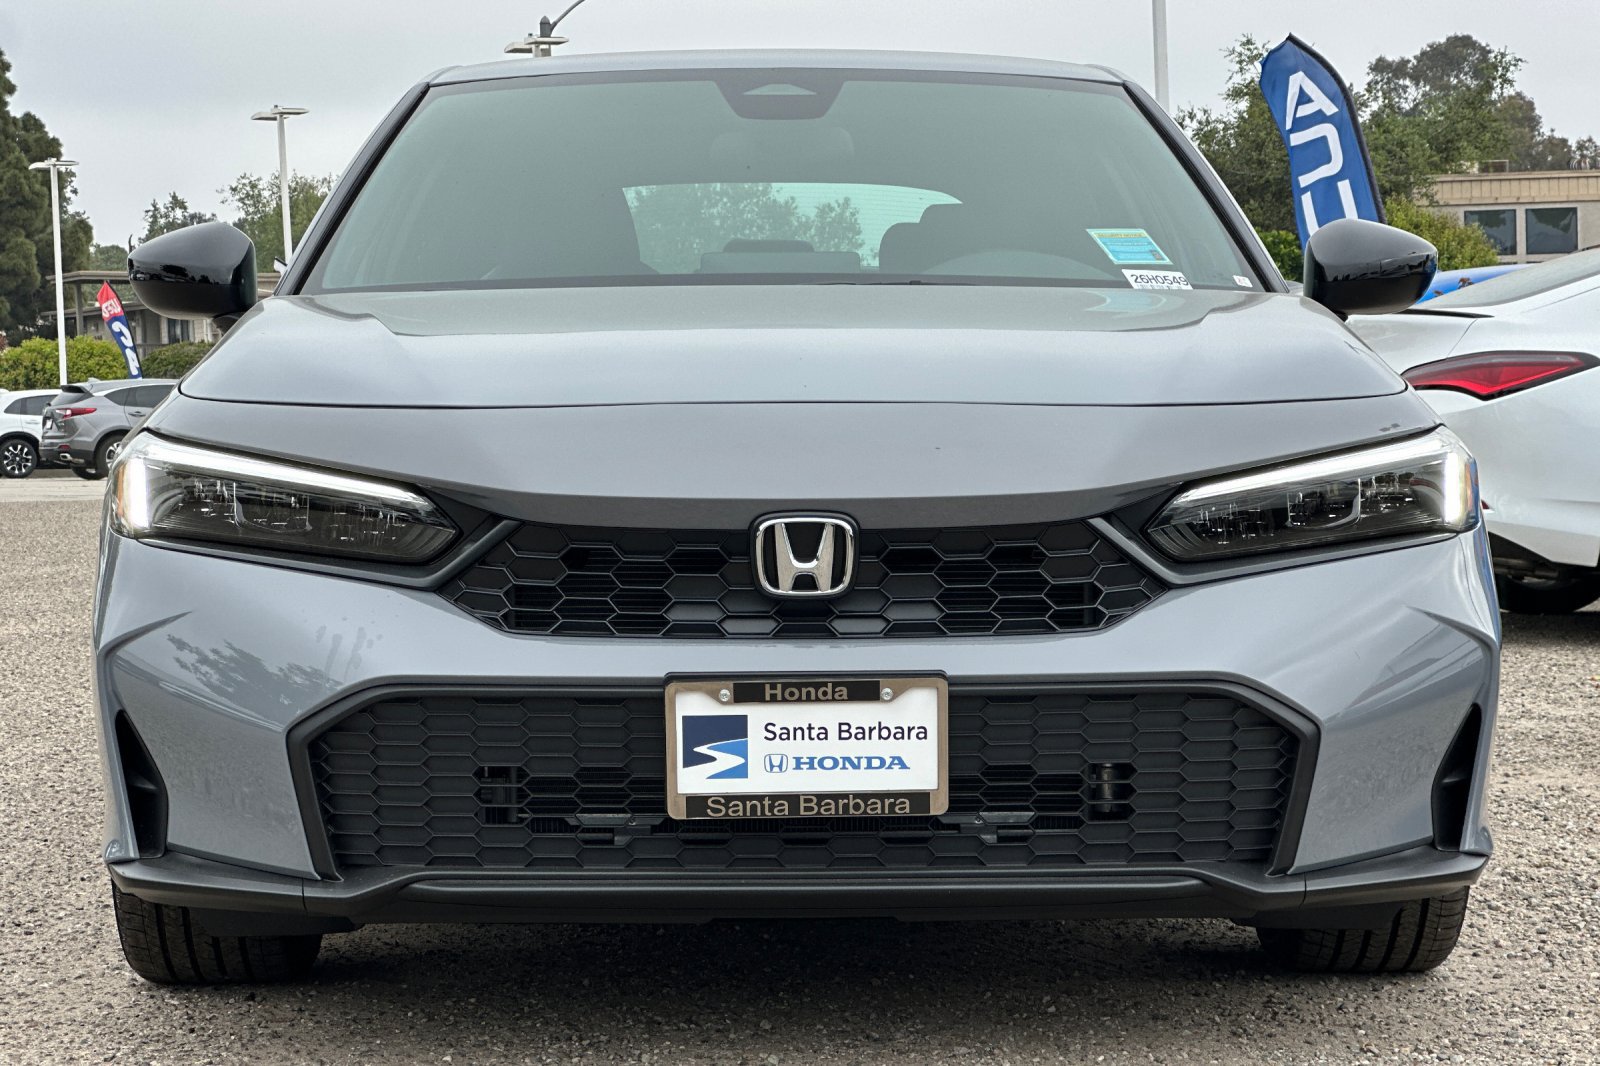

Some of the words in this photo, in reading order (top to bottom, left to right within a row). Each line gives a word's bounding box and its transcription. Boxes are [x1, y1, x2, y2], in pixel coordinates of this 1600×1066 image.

[764, 683, 849, 701] Honda
[763, 722, 829, 741] Santa
[838, 721, 928, 741] Barbara
[792, 755, 911, 771] HONDA
[706, 795, 790, 818] Santa
[798, 794, 911, 815] Barbara
